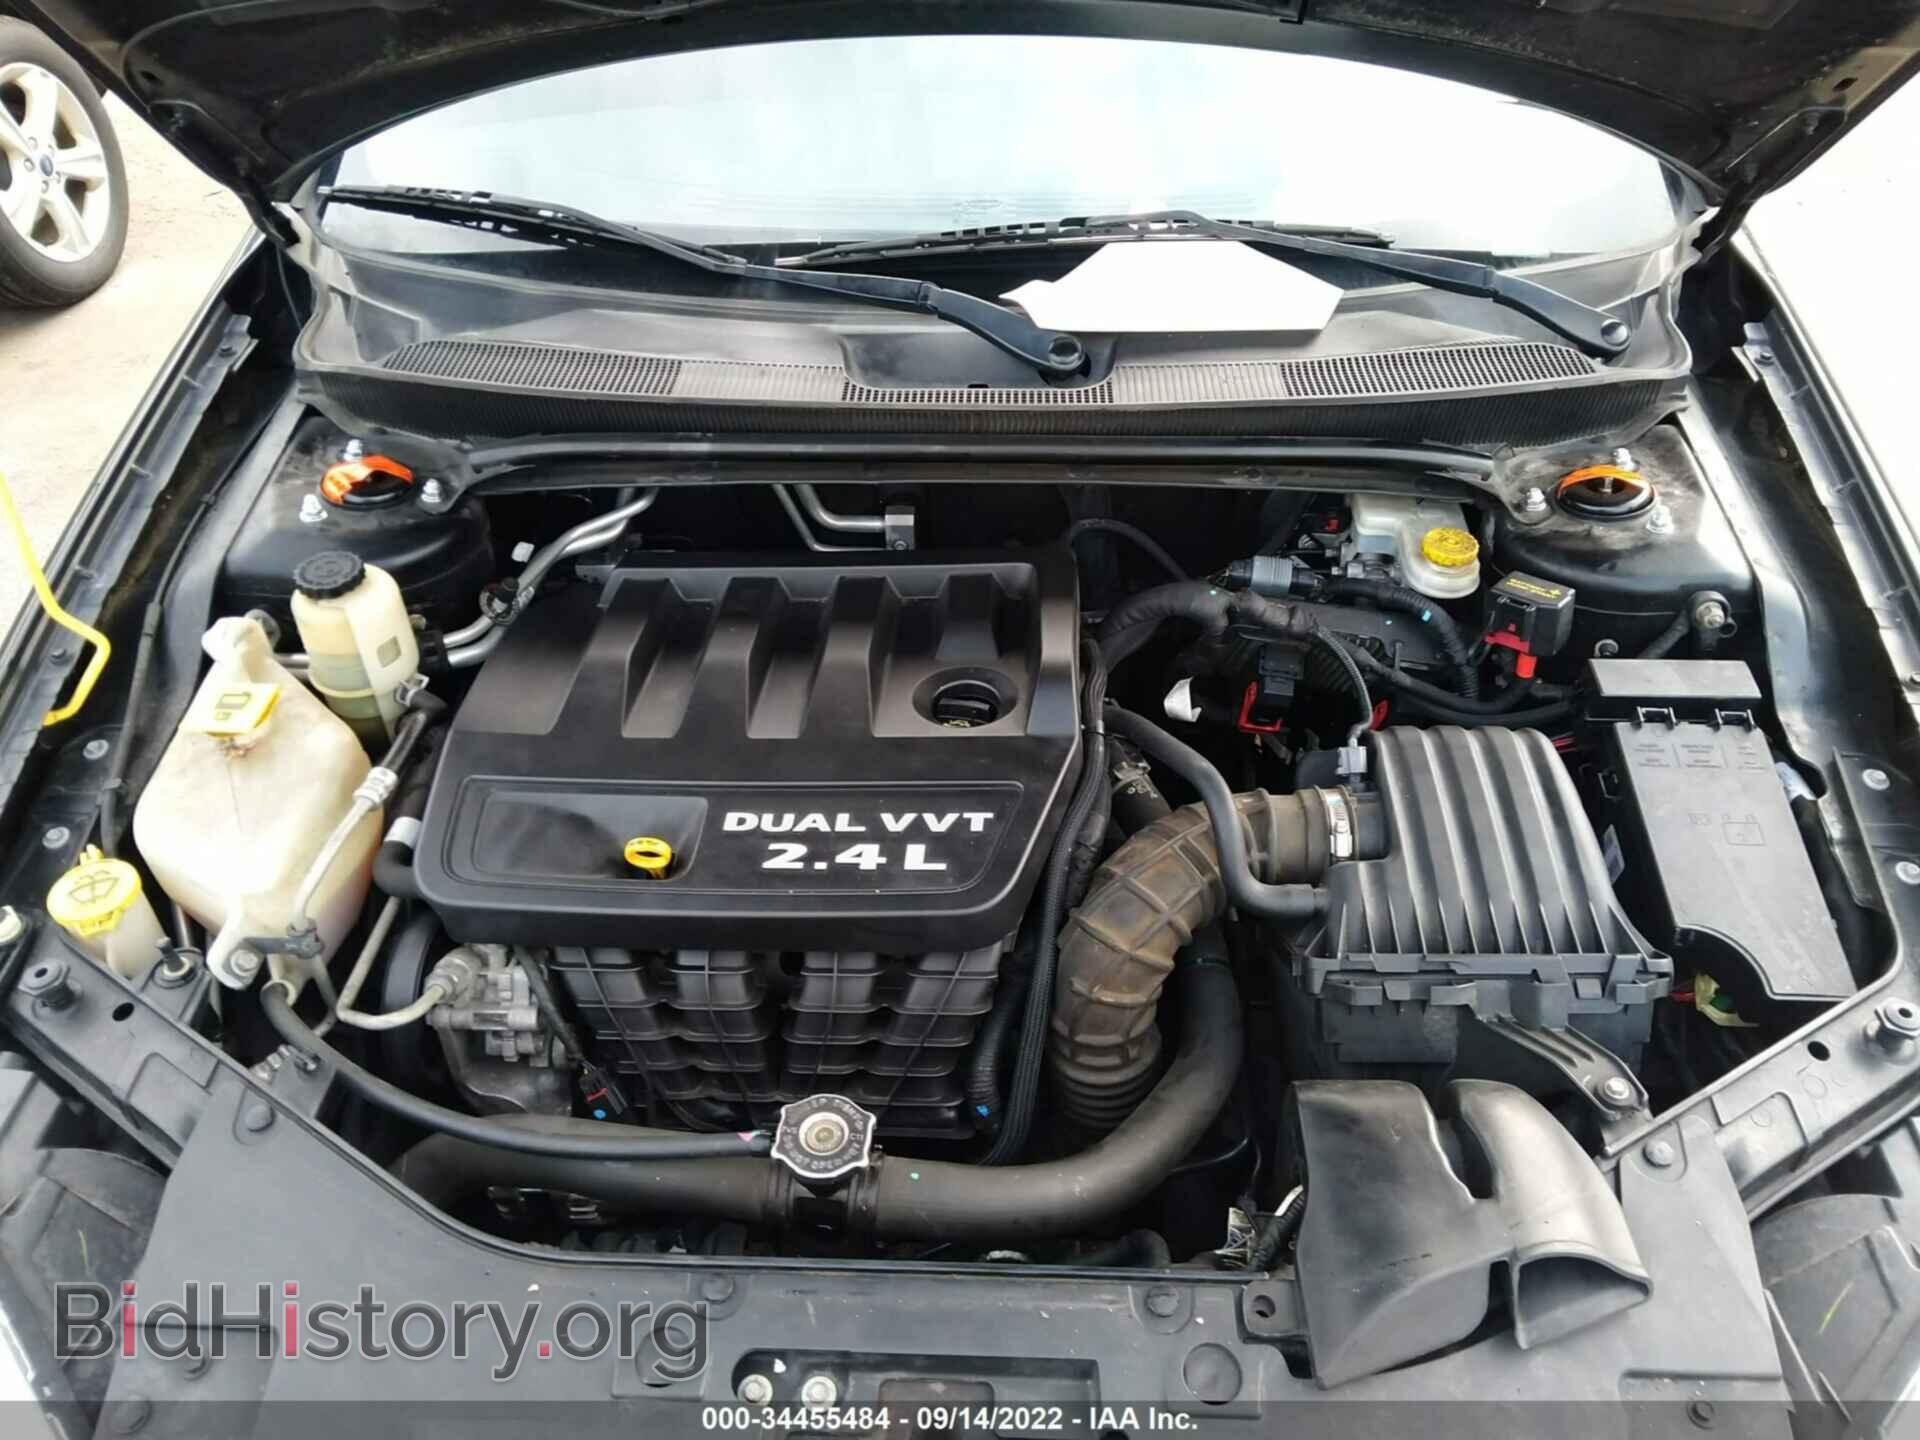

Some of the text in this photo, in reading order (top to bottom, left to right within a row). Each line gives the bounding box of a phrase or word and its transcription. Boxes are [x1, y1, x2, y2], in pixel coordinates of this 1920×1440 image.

[722, 811, 994, 833] DUAL VVT
[761, 842, 948, 871] 2.4 L
